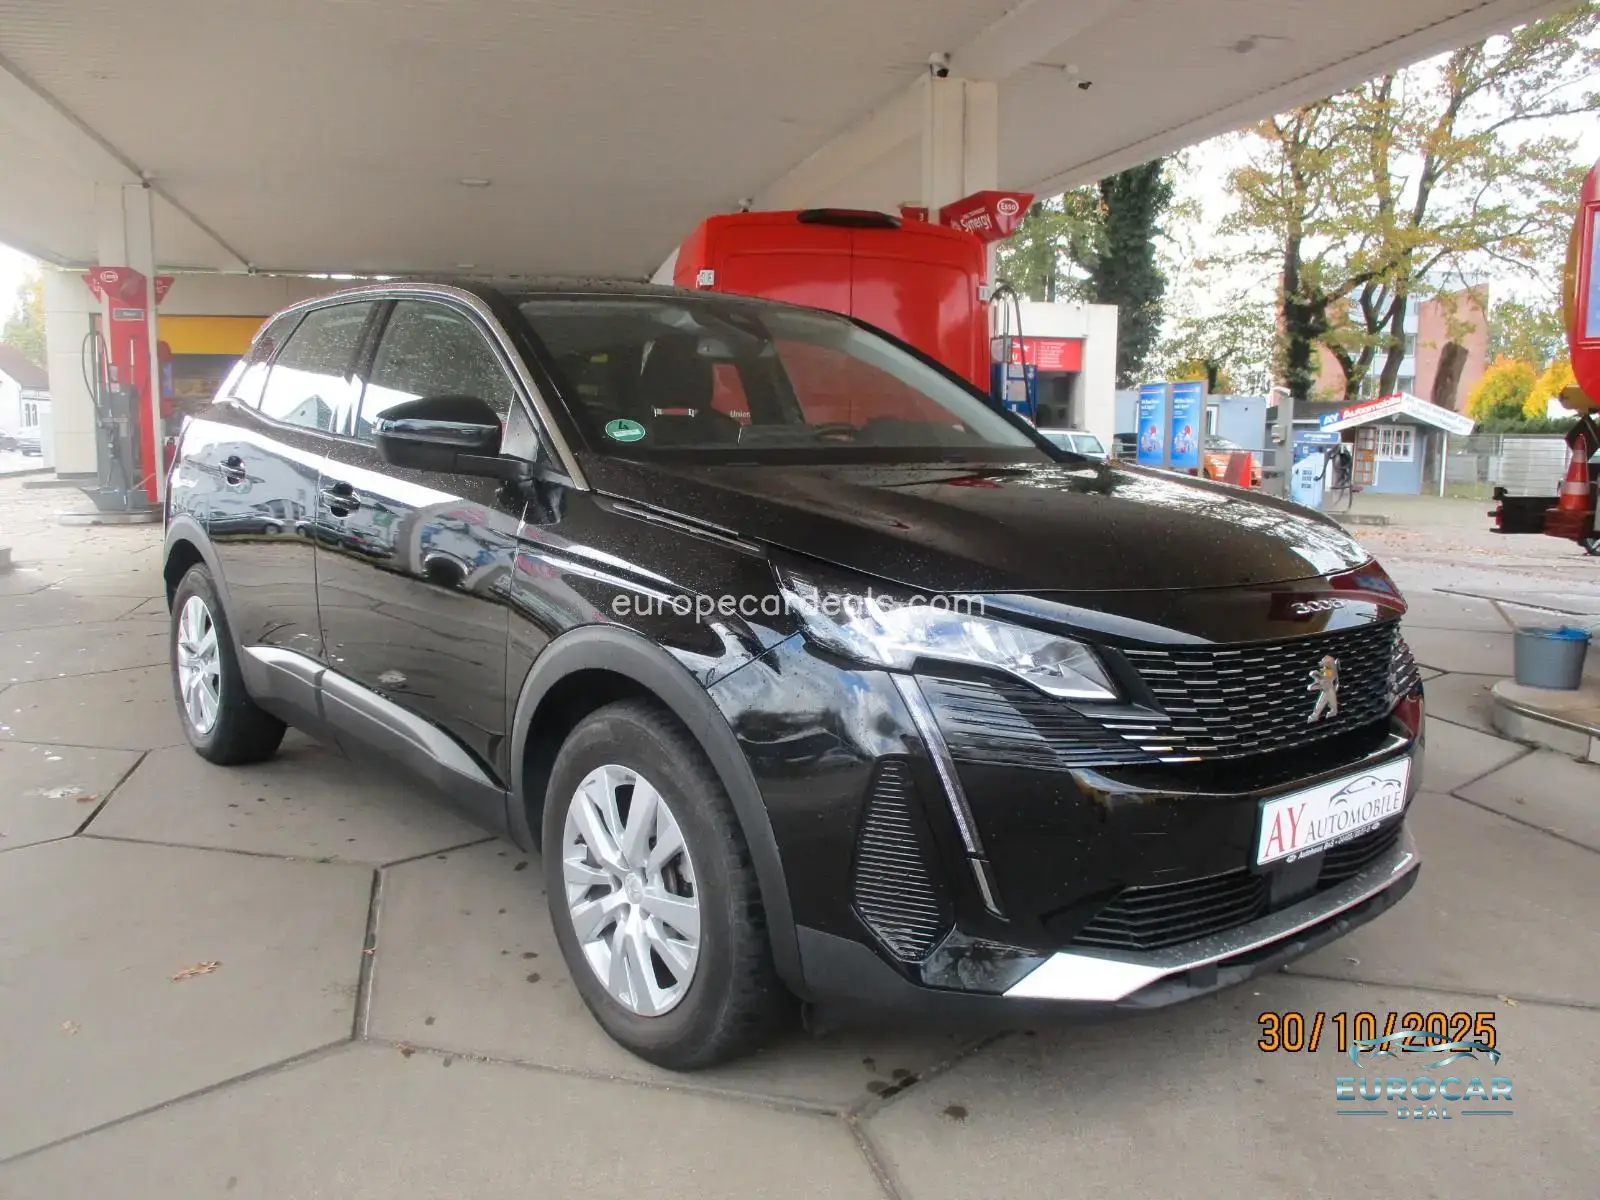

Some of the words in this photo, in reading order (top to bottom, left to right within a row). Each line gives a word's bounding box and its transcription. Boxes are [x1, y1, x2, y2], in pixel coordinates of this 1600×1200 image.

[1000, 202, 1016, 211] Esso
[960, 213, 993, 236] Synergy
[1324, 413, 1339, 425] AY
[1291, 598, 1345, 614] 3008
[1264, 803, 1306, 858] AY
[1304, 791, 1401, 845] AUTOMOBILE
